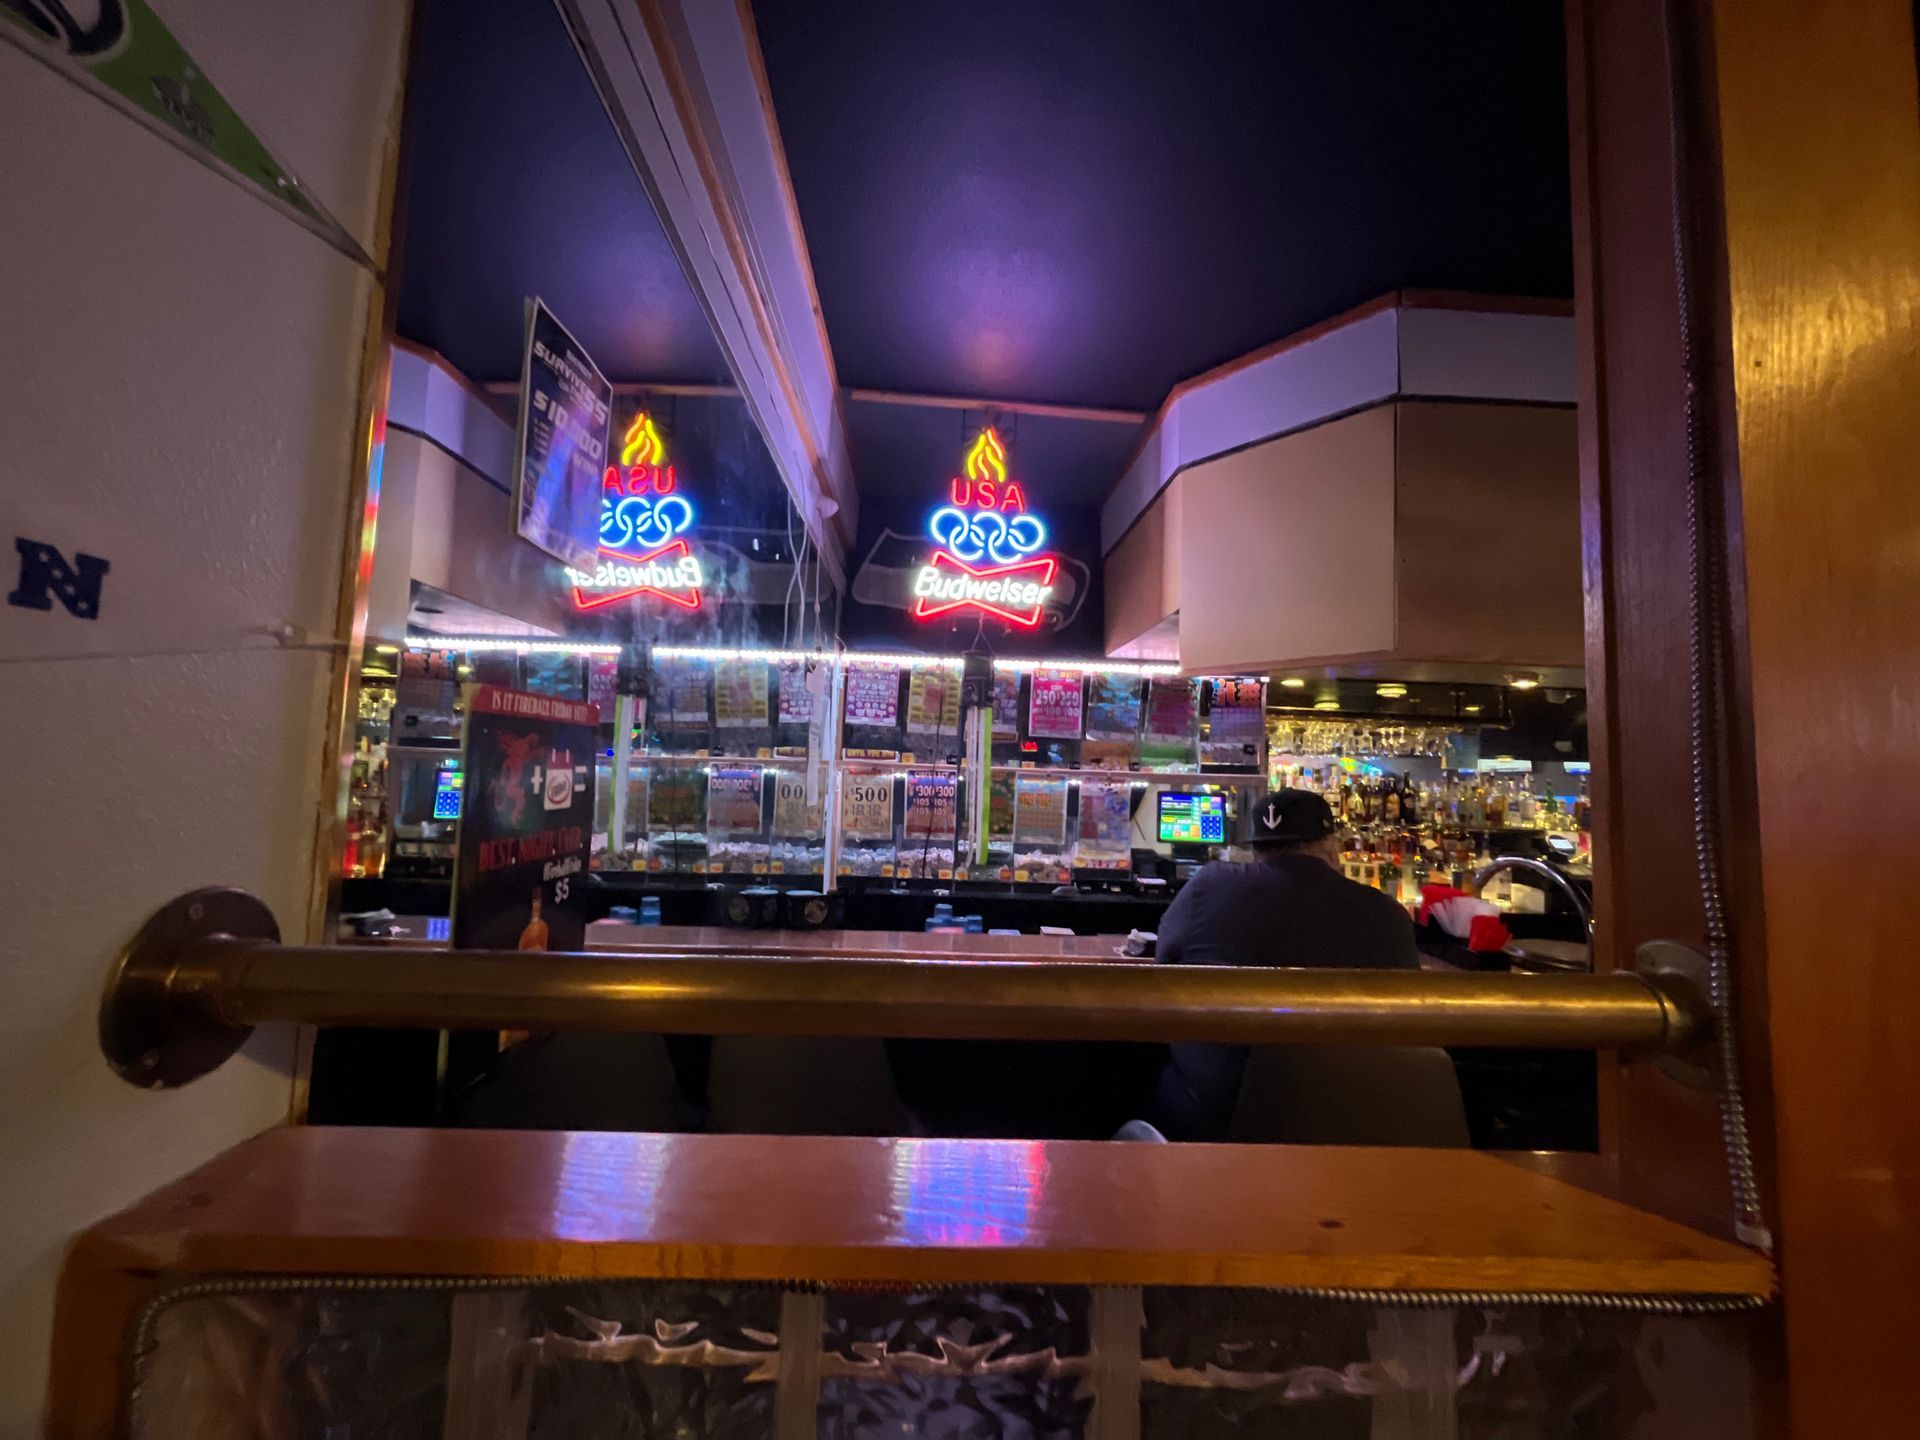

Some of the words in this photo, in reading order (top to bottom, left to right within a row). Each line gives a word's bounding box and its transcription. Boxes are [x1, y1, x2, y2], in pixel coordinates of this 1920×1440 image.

[951, 478, 1026, 513] USA
[914, 565, 1053, 605] Budweiser
[491, 690, 502, 710] IS
[502, 692, 513, 711] IT
[850, 786, 888, 803] $500
[554, 877, 570, 905] $5
